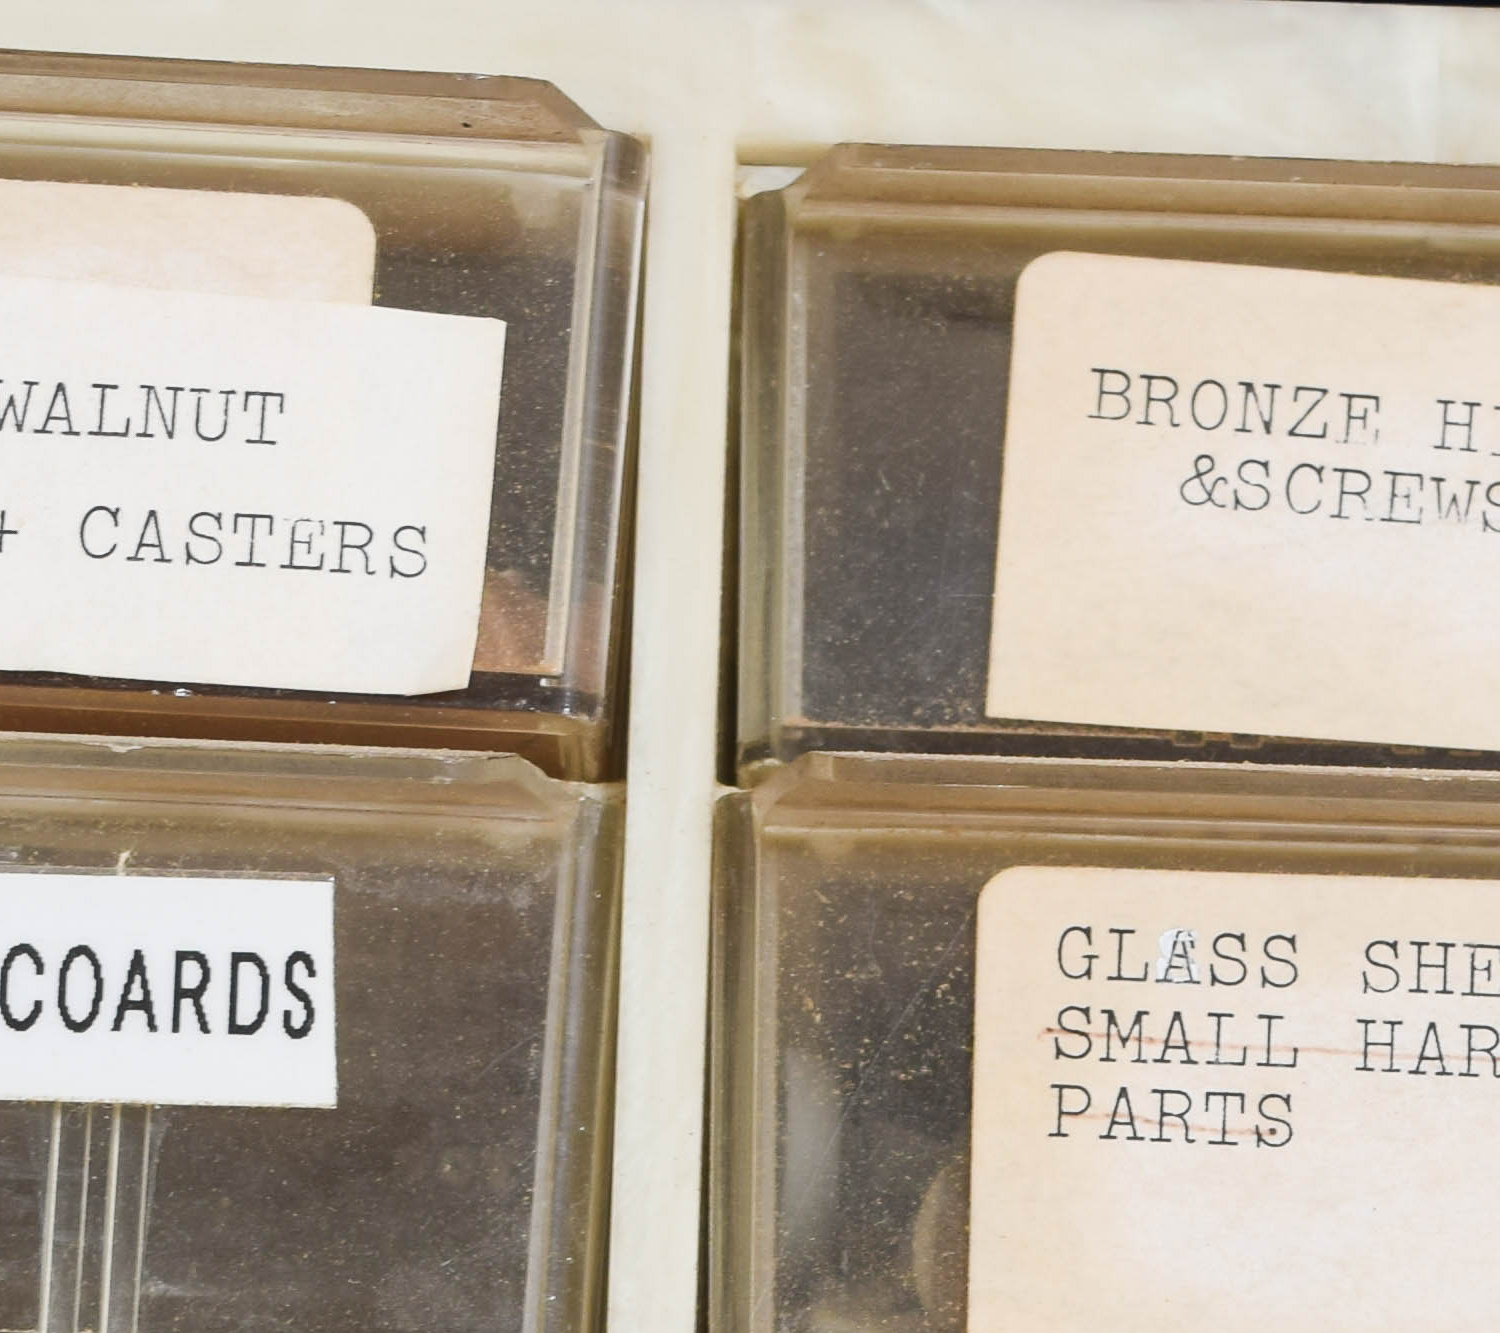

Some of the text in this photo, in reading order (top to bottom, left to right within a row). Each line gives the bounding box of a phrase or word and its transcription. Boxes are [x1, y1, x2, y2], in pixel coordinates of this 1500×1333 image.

[1087, 367, 1381, 444] BRONZE
[79, 505, 428, 579] CASTERS
[1057, 925, 1299, 989] GLASS
[1047, 1005, 1300, 1069] SMALL
[1047, 1083, 1294, 1149] PARTS
